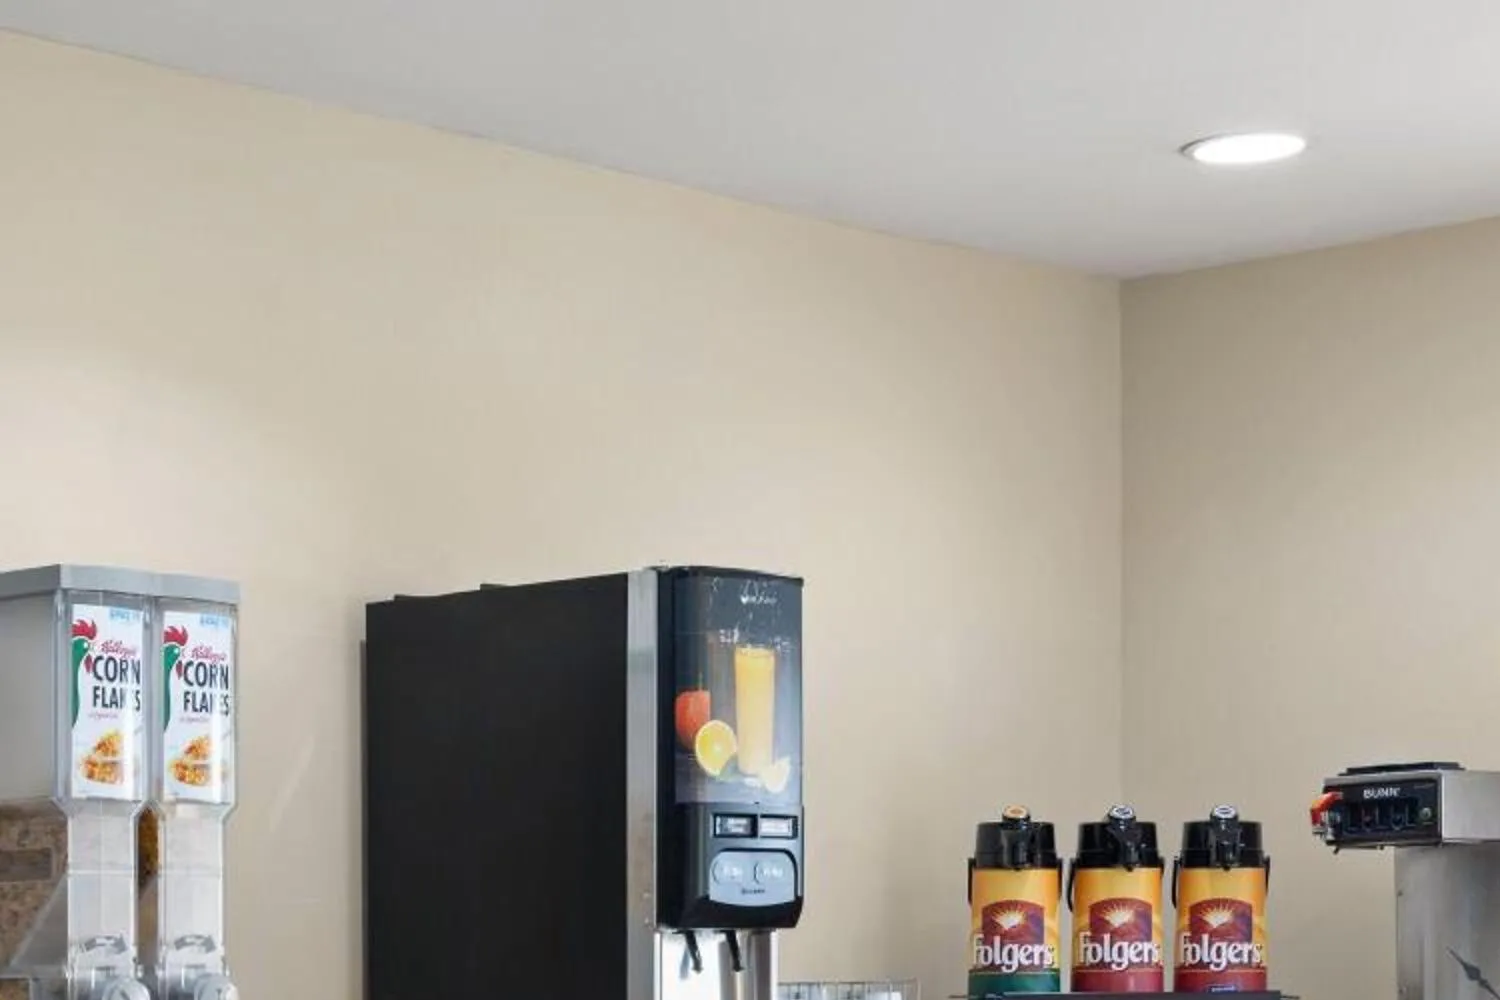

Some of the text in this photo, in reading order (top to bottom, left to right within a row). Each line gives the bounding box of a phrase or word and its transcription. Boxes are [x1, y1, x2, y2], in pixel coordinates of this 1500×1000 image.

[92, 655, 141, 685] CORN
[183, 660, 229, 690] CORN
[92, 686, 141, 712] FLAS
[975, 934, 1055, 972] Folgers
[1078, 931, 1160, 971] Folgers
[1179, 931, 1262, 971] Folgers
